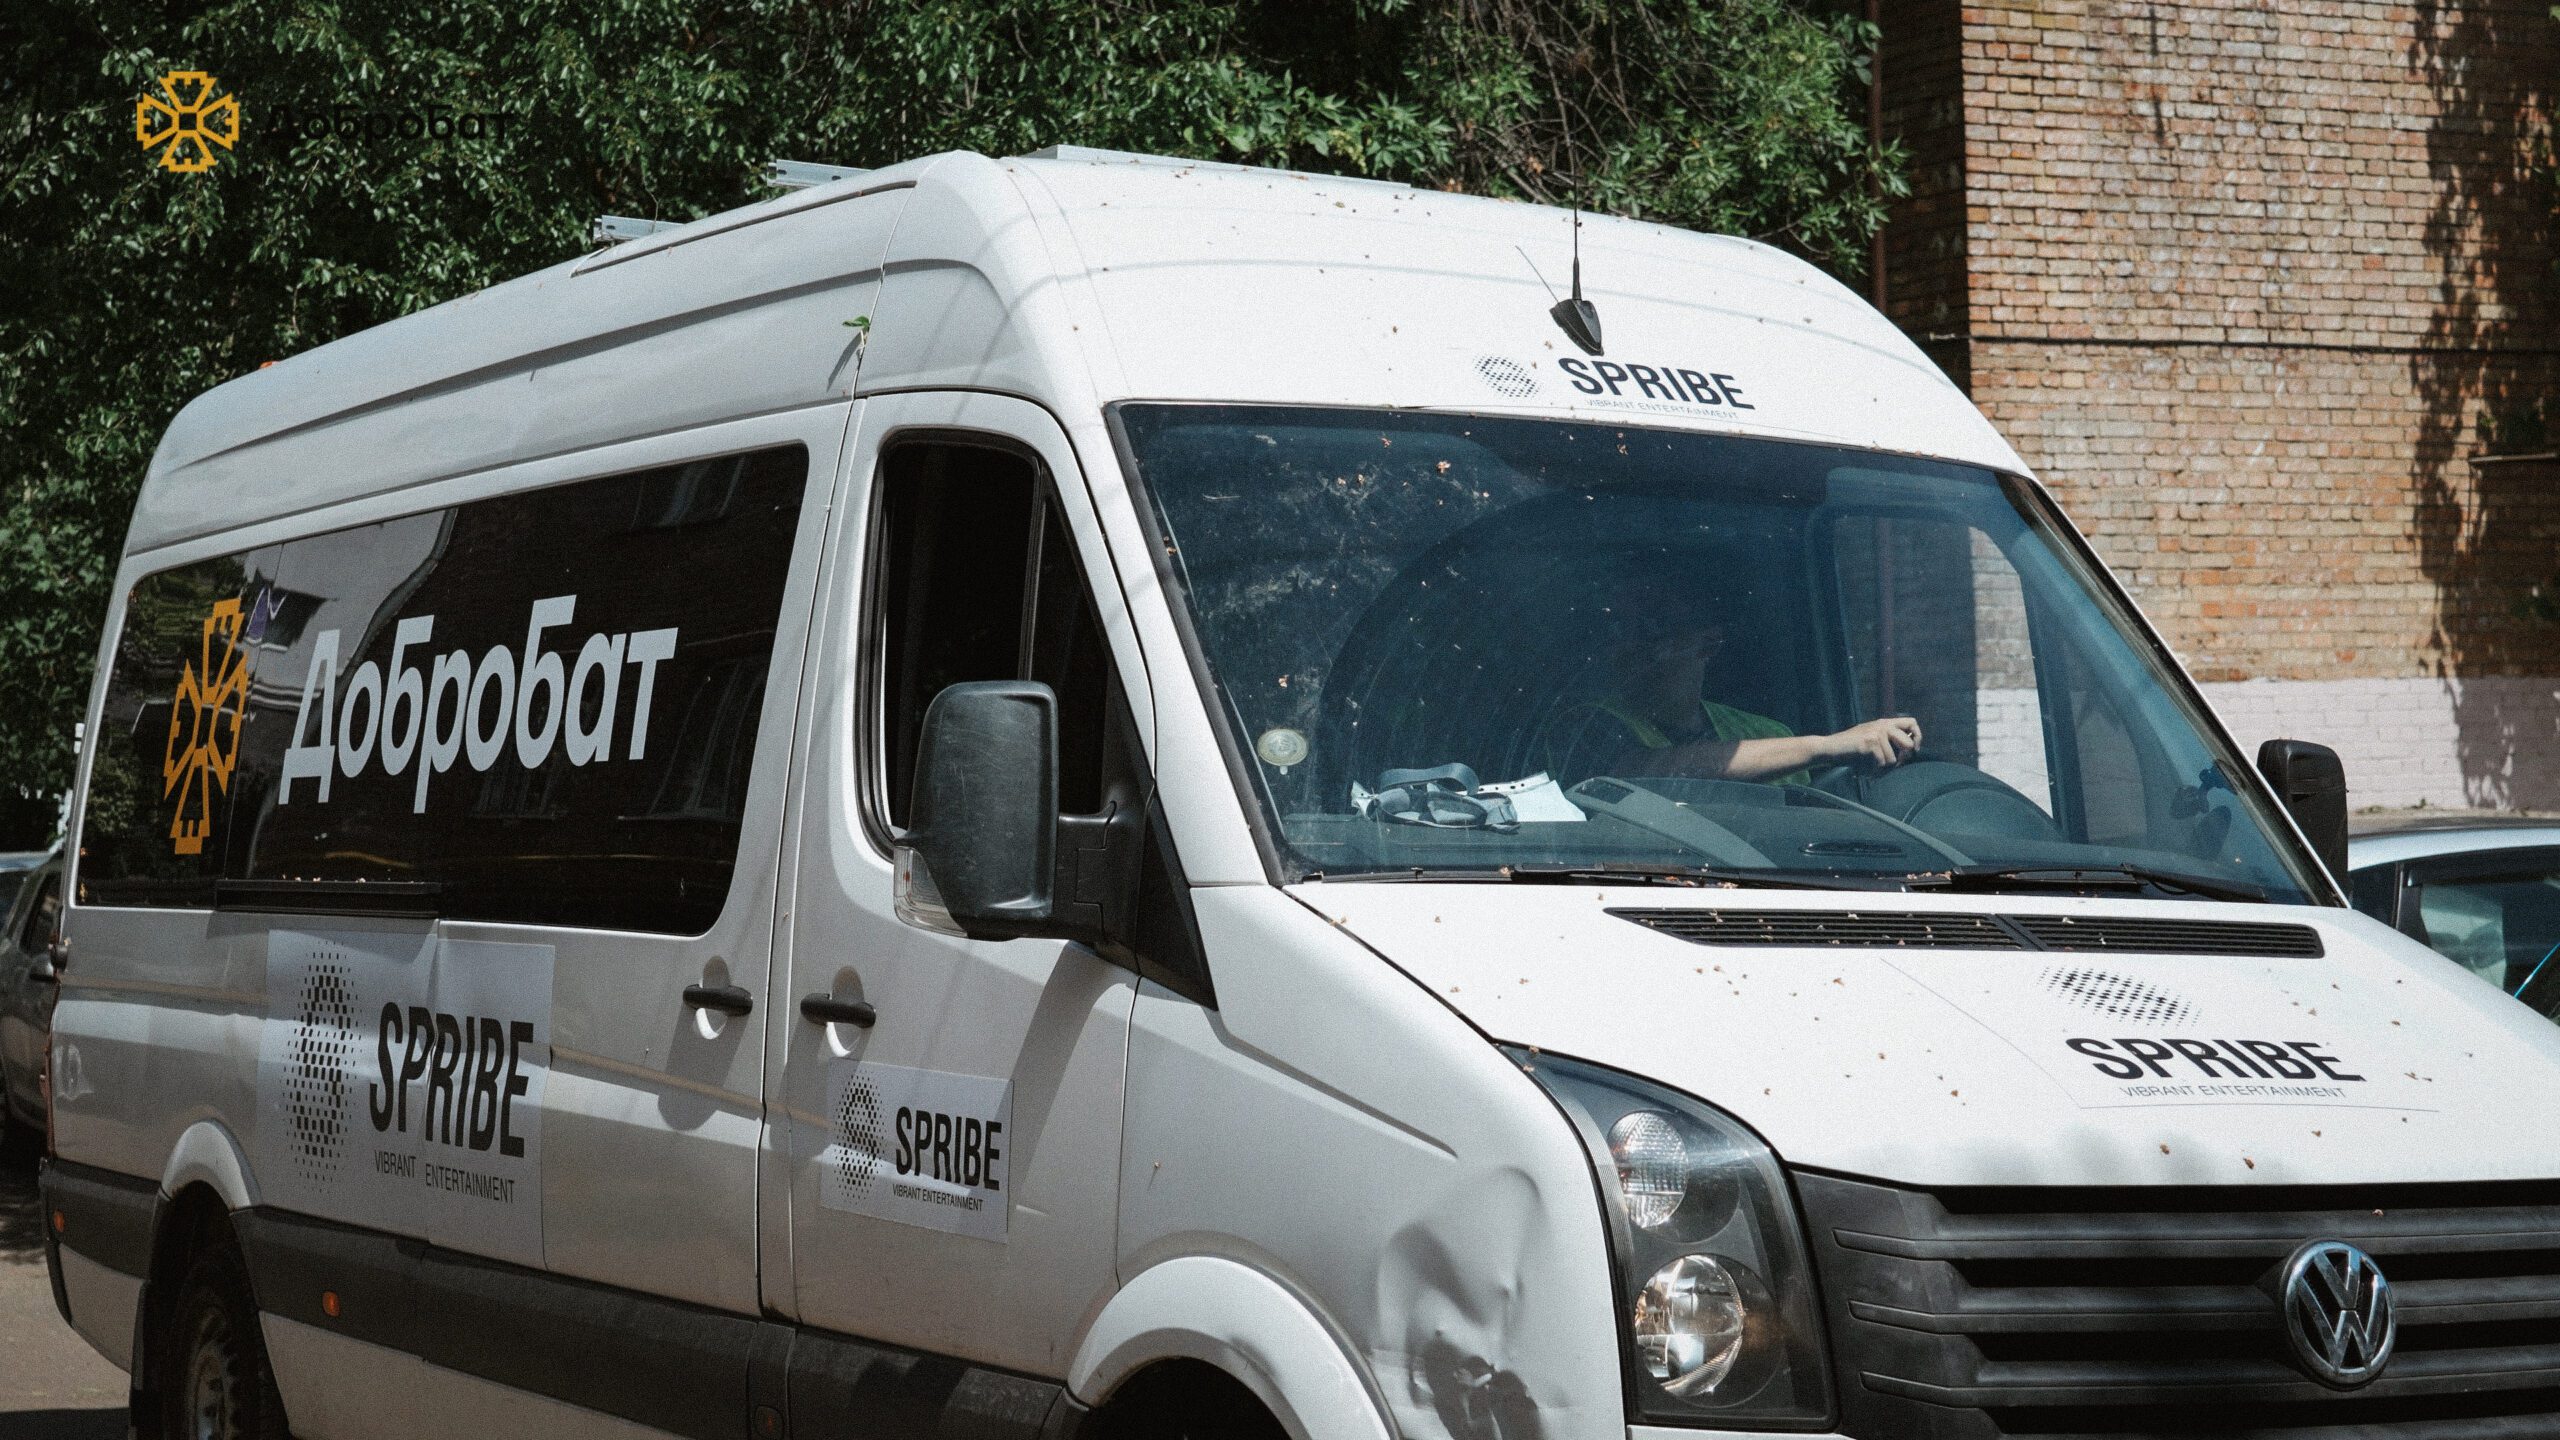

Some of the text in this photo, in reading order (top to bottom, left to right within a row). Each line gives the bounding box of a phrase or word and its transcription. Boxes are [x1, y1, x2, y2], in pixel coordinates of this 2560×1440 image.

[1558, 358, 1755, 410] SPRIBE
[1586, 399, 1635, 410] VIBRANT
[278, 594, 678, 814] Добробат
[369, 1001, 534, 1158] SPRIBE
[2065, 1037, 2367, 1082] SPRIBE
[2119, 1084, 2347, 1099] VIBRANT ENTERTAINMENT
[895, 1106, 1002, 1191] SPRIBE
[374, 1151, 515, 1204] VIBRANT ENTERTAINMENT
[892, 1183, 984, 1212] VIBRANT ENTERTAINMENT
